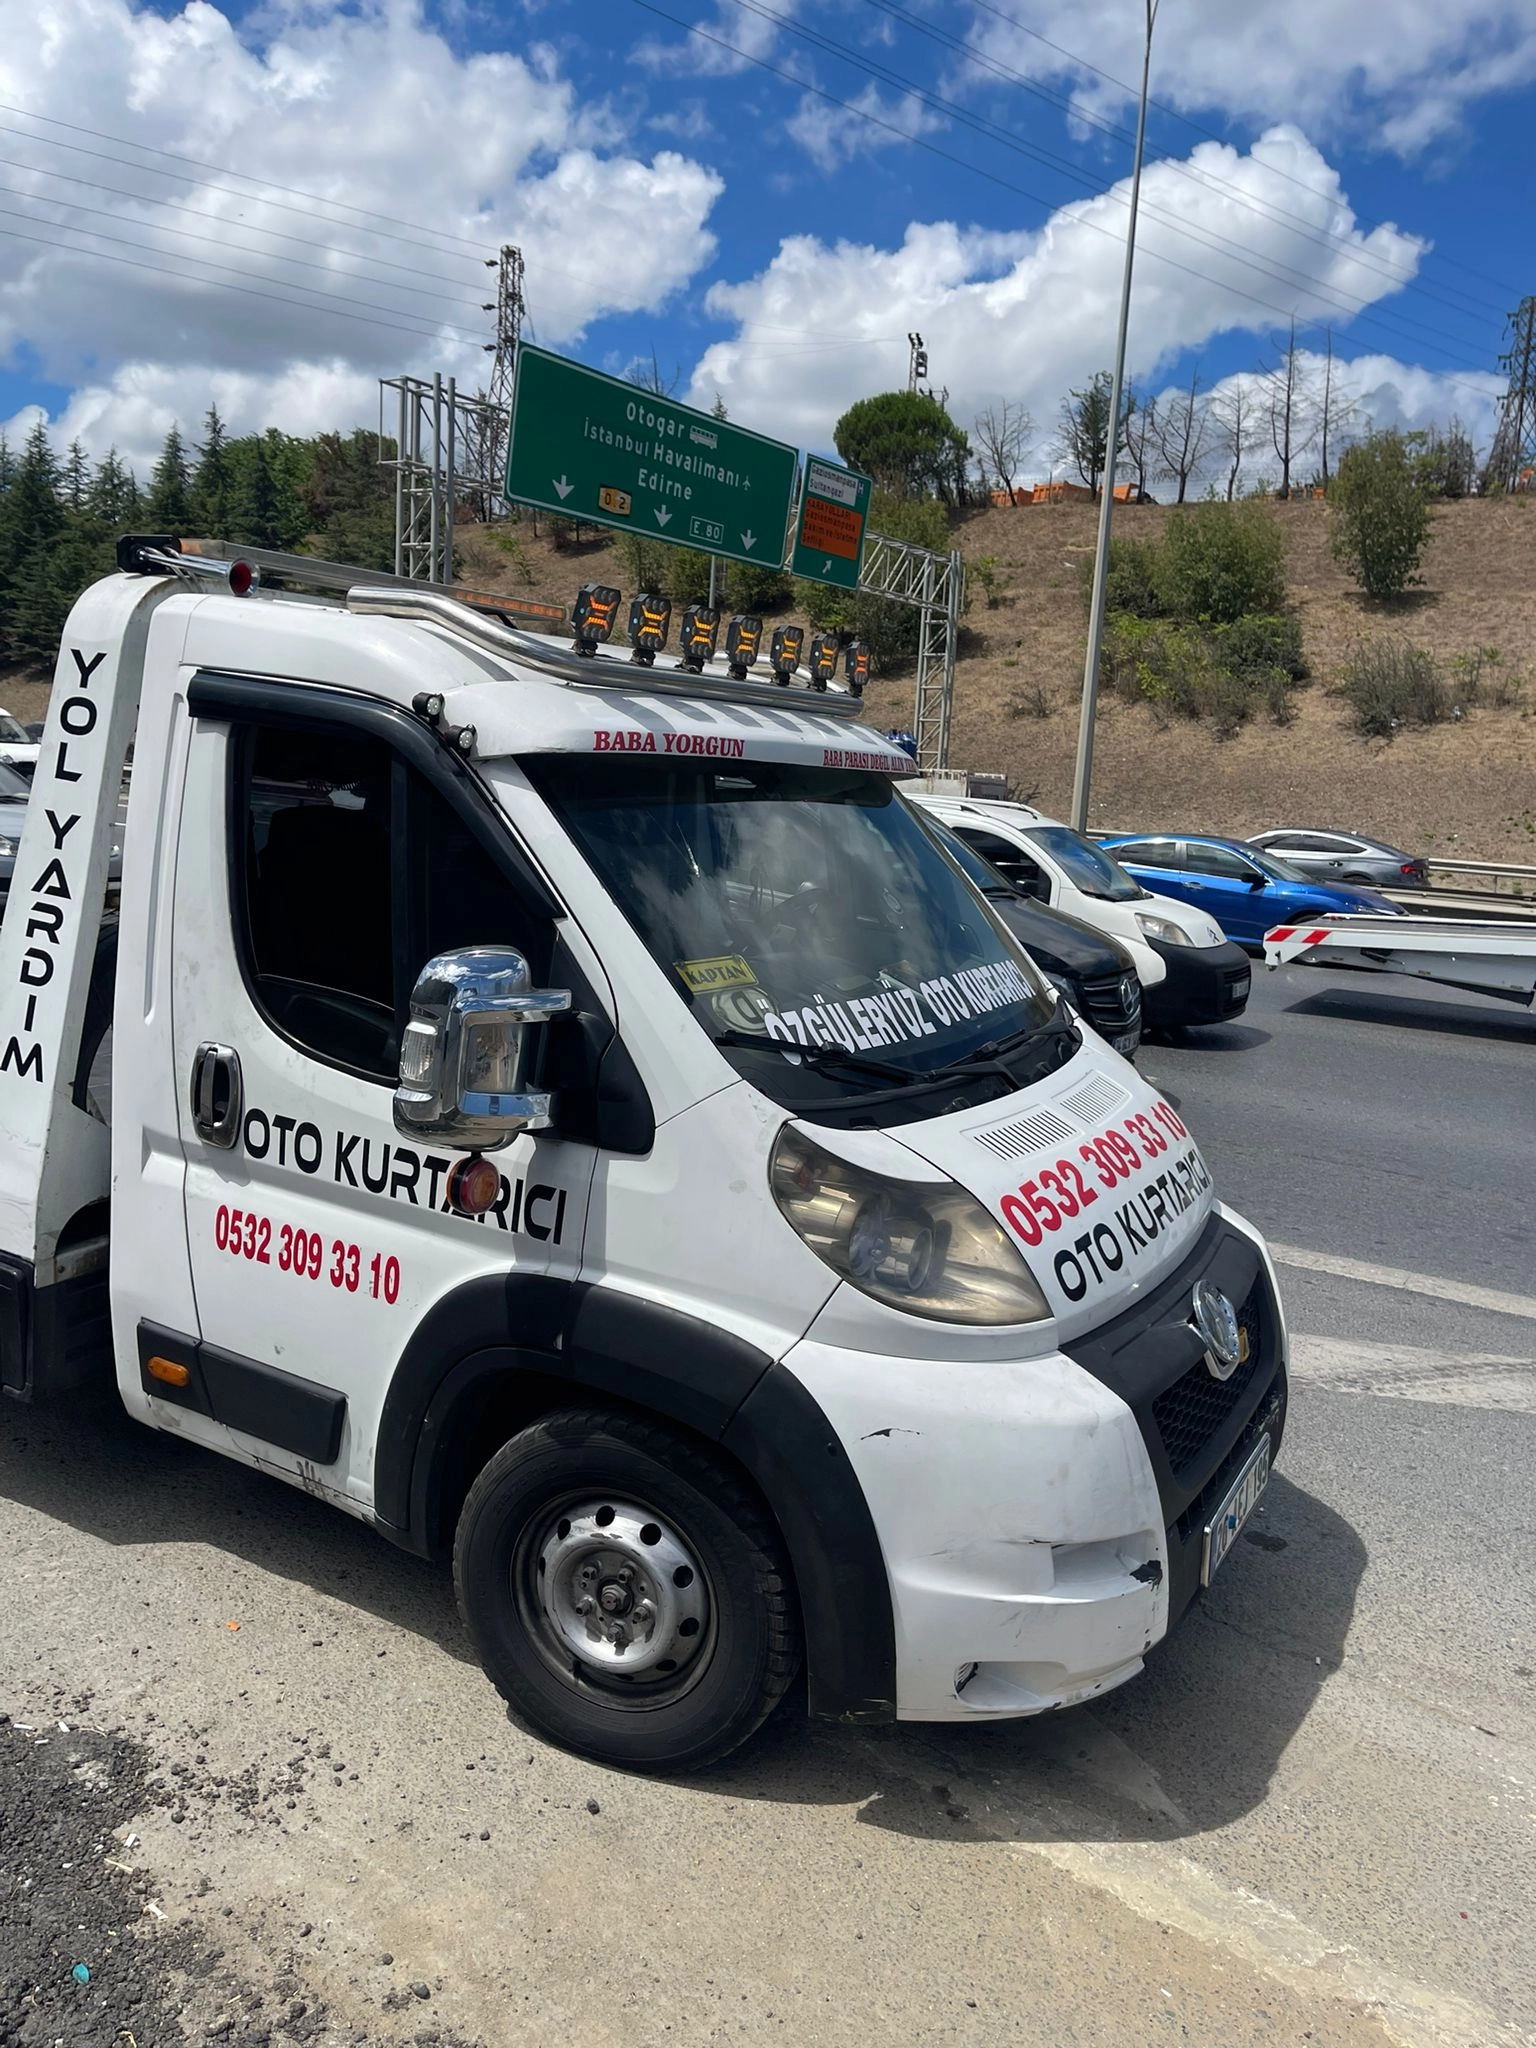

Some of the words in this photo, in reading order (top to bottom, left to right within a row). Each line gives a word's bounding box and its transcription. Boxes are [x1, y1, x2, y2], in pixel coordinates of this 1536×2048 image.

[584, 417, 649, 456] İstanbul
[653, 445, 739, 487] Havalimanı
[626, 402, 685, 438] Otogar
[638, 468, 693, 500] Edirne
[54, 648, 108, 783] YOL
[593, 730, 656, 752] BABA
[662, 733, 745, 758] YORGUN
[823, 749, 843, 767] BABA
[844, 751, 868, 769] PARASI
[0, 808, 82, 1083] YARDIM
[685, 964, 748, 986] KAPTAN
[920, 976, 970, 1026] OTO
[952, 959, 1035, 1020] KURTARICI
[243, 1108, 322, 1175] OTO
[335, 1130, 567, 1245] KURTRICI
[1000, 1159, 1099, 1247] 0532
[1079, 1129, 1142, 1189] 309
[1123, 1113, 1168, 1158] 33
[1151, 1101, 1188, 1142] 10
[215, 1204, 272, 1265] 0532
[278, 1223, 323, 1280] 309
[330, 1239, 361, 1293] 33
[370, 1252, 400, 1305] 10
[1053, 1223, 1123, 1302] OTO
[1114, 1148, 1211, 1255] KURTARICI
